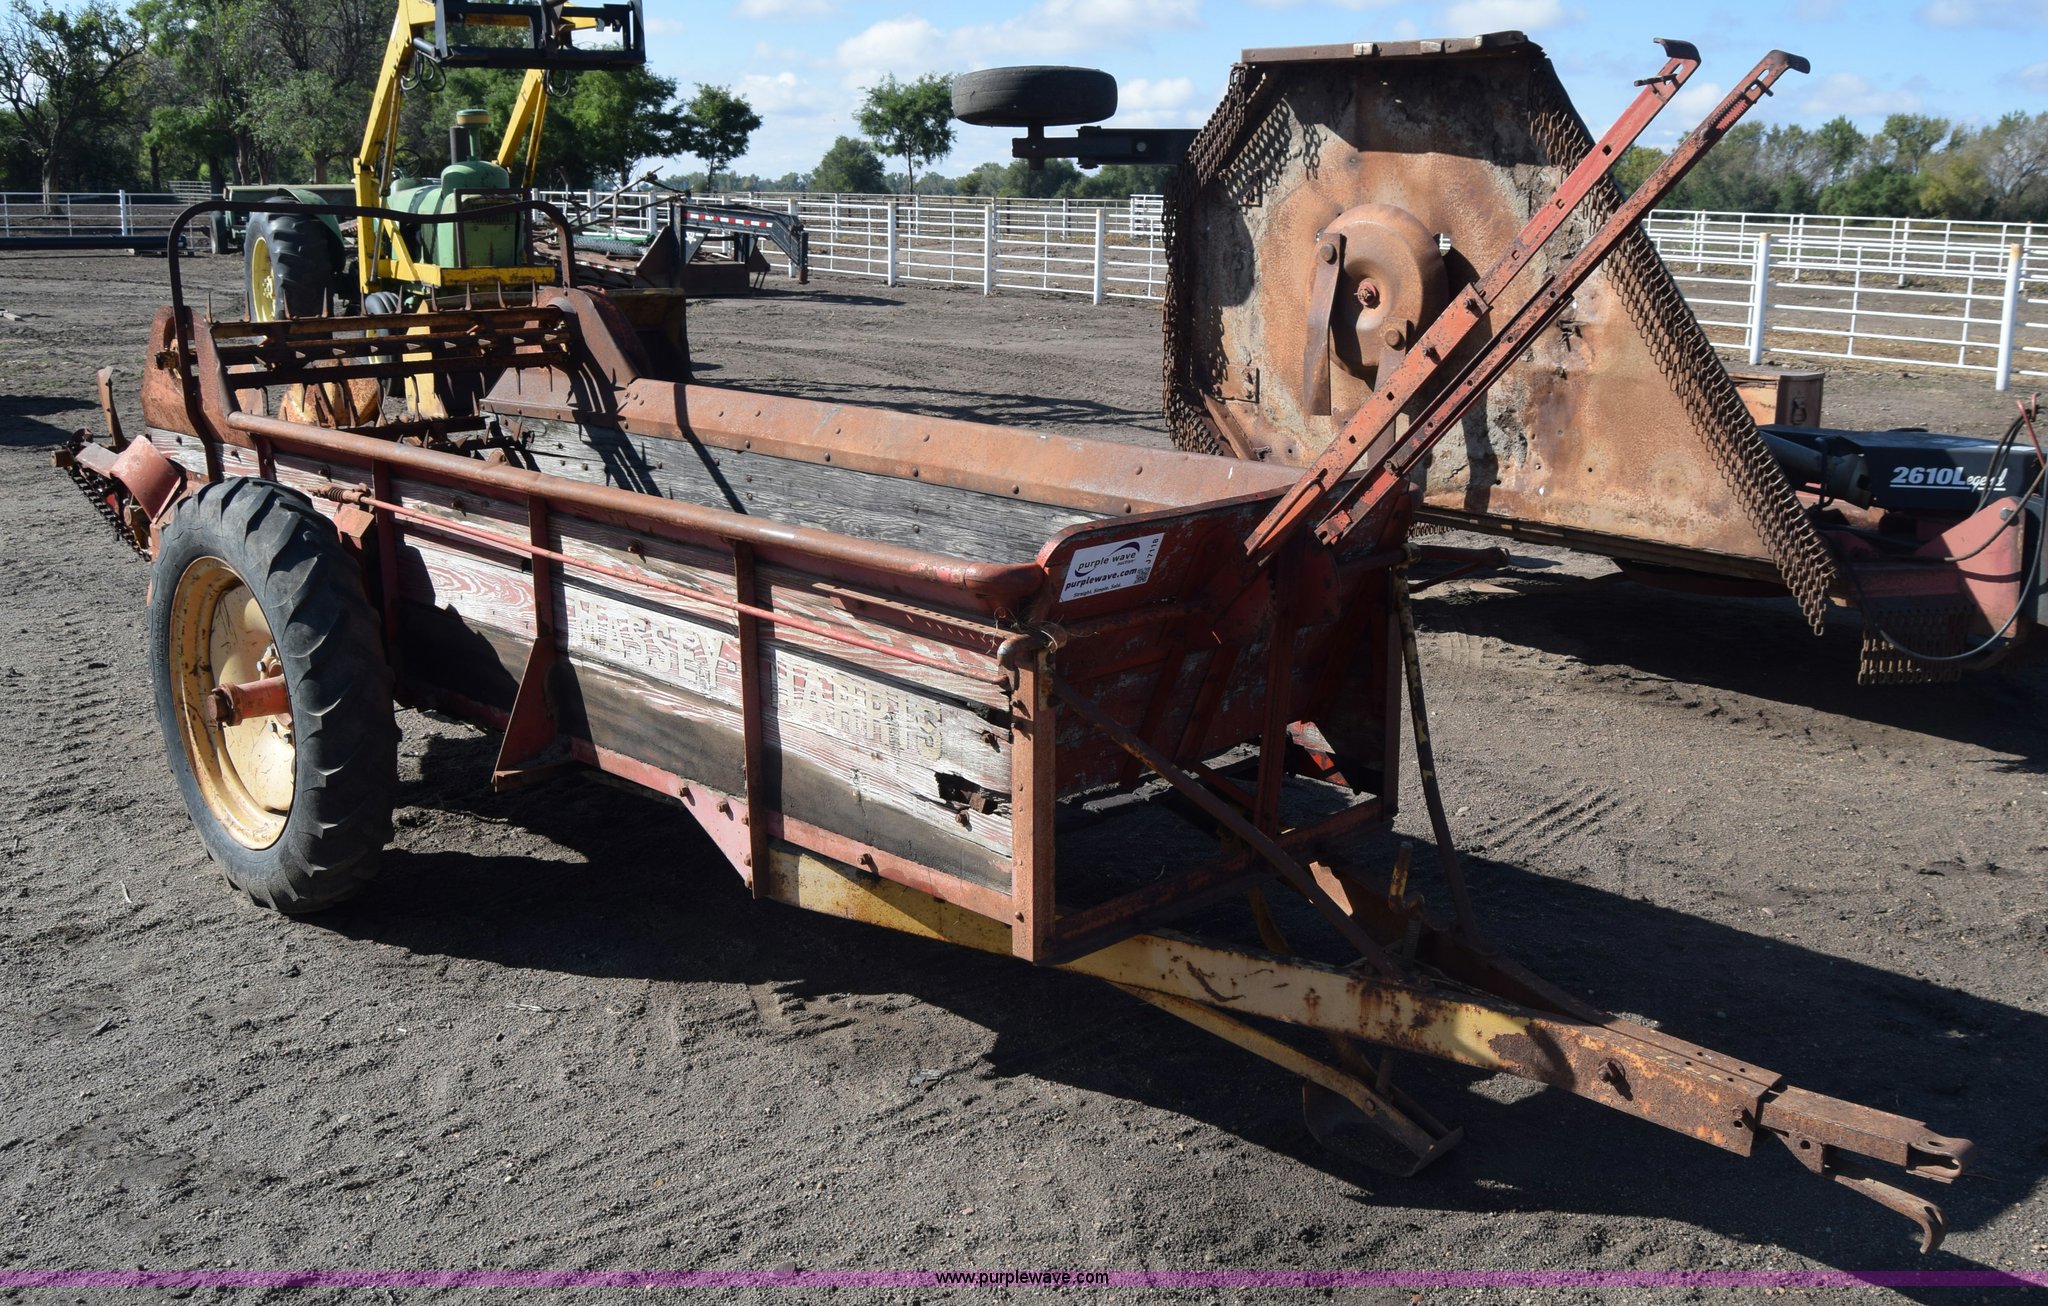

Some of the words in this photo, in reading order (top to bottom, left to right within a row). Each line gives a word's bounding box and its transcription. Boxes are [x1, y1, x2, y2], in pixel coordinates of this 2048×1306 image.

[1078, 556, 1109, 571] purple
[1112, 552, 1136, 562] wave
[1065, 568, 1138, 591] purplewave.com
